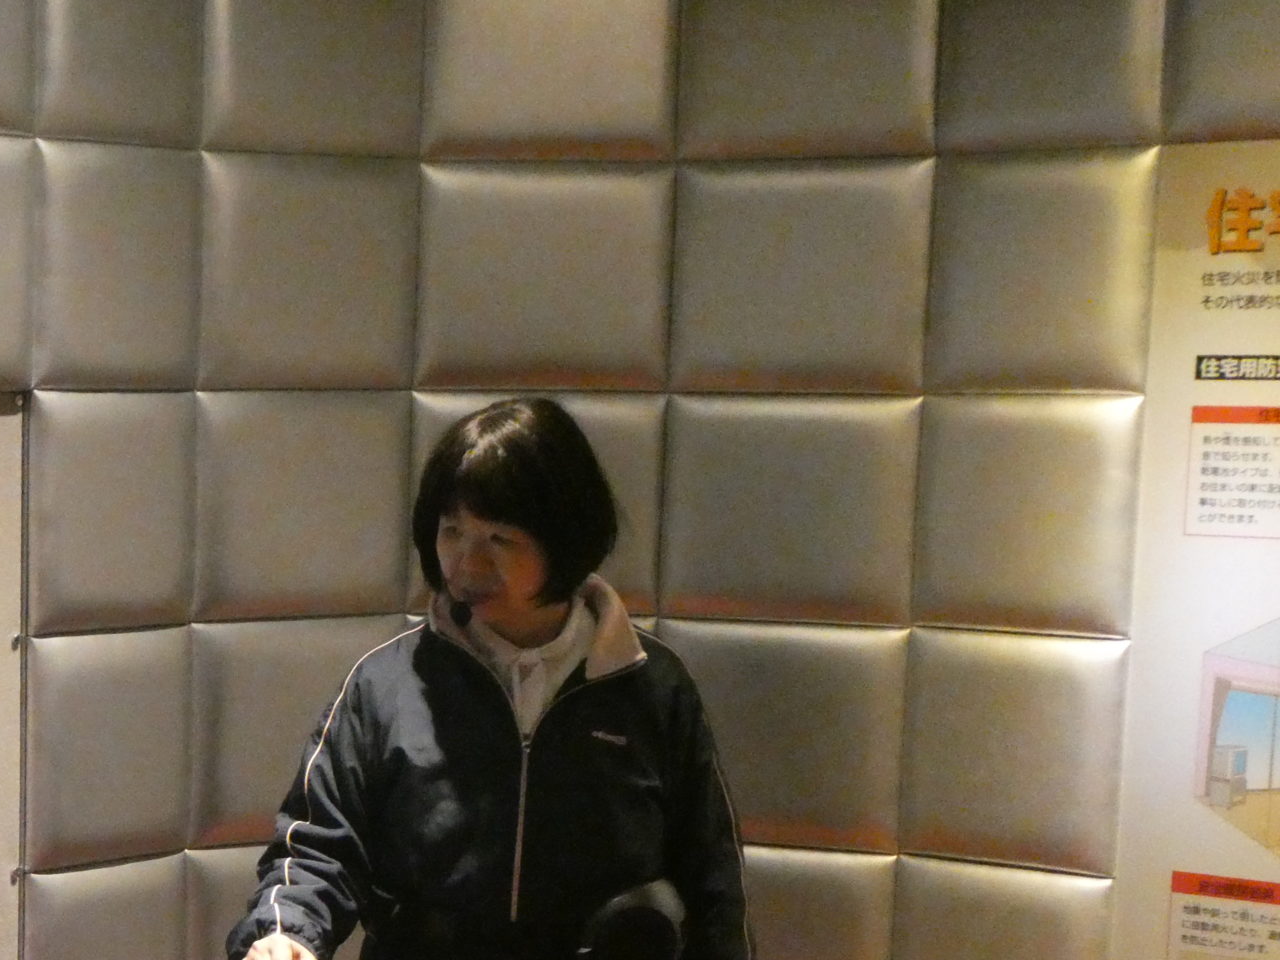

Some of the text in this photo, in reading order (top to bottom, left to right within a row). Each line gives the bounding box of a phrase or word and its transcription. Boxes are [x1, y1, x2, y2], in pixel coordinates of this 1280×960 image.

[1201, 270, 1280, 288] 住宅火災を
[1200, 357, 1280, 378] 住宅用防
